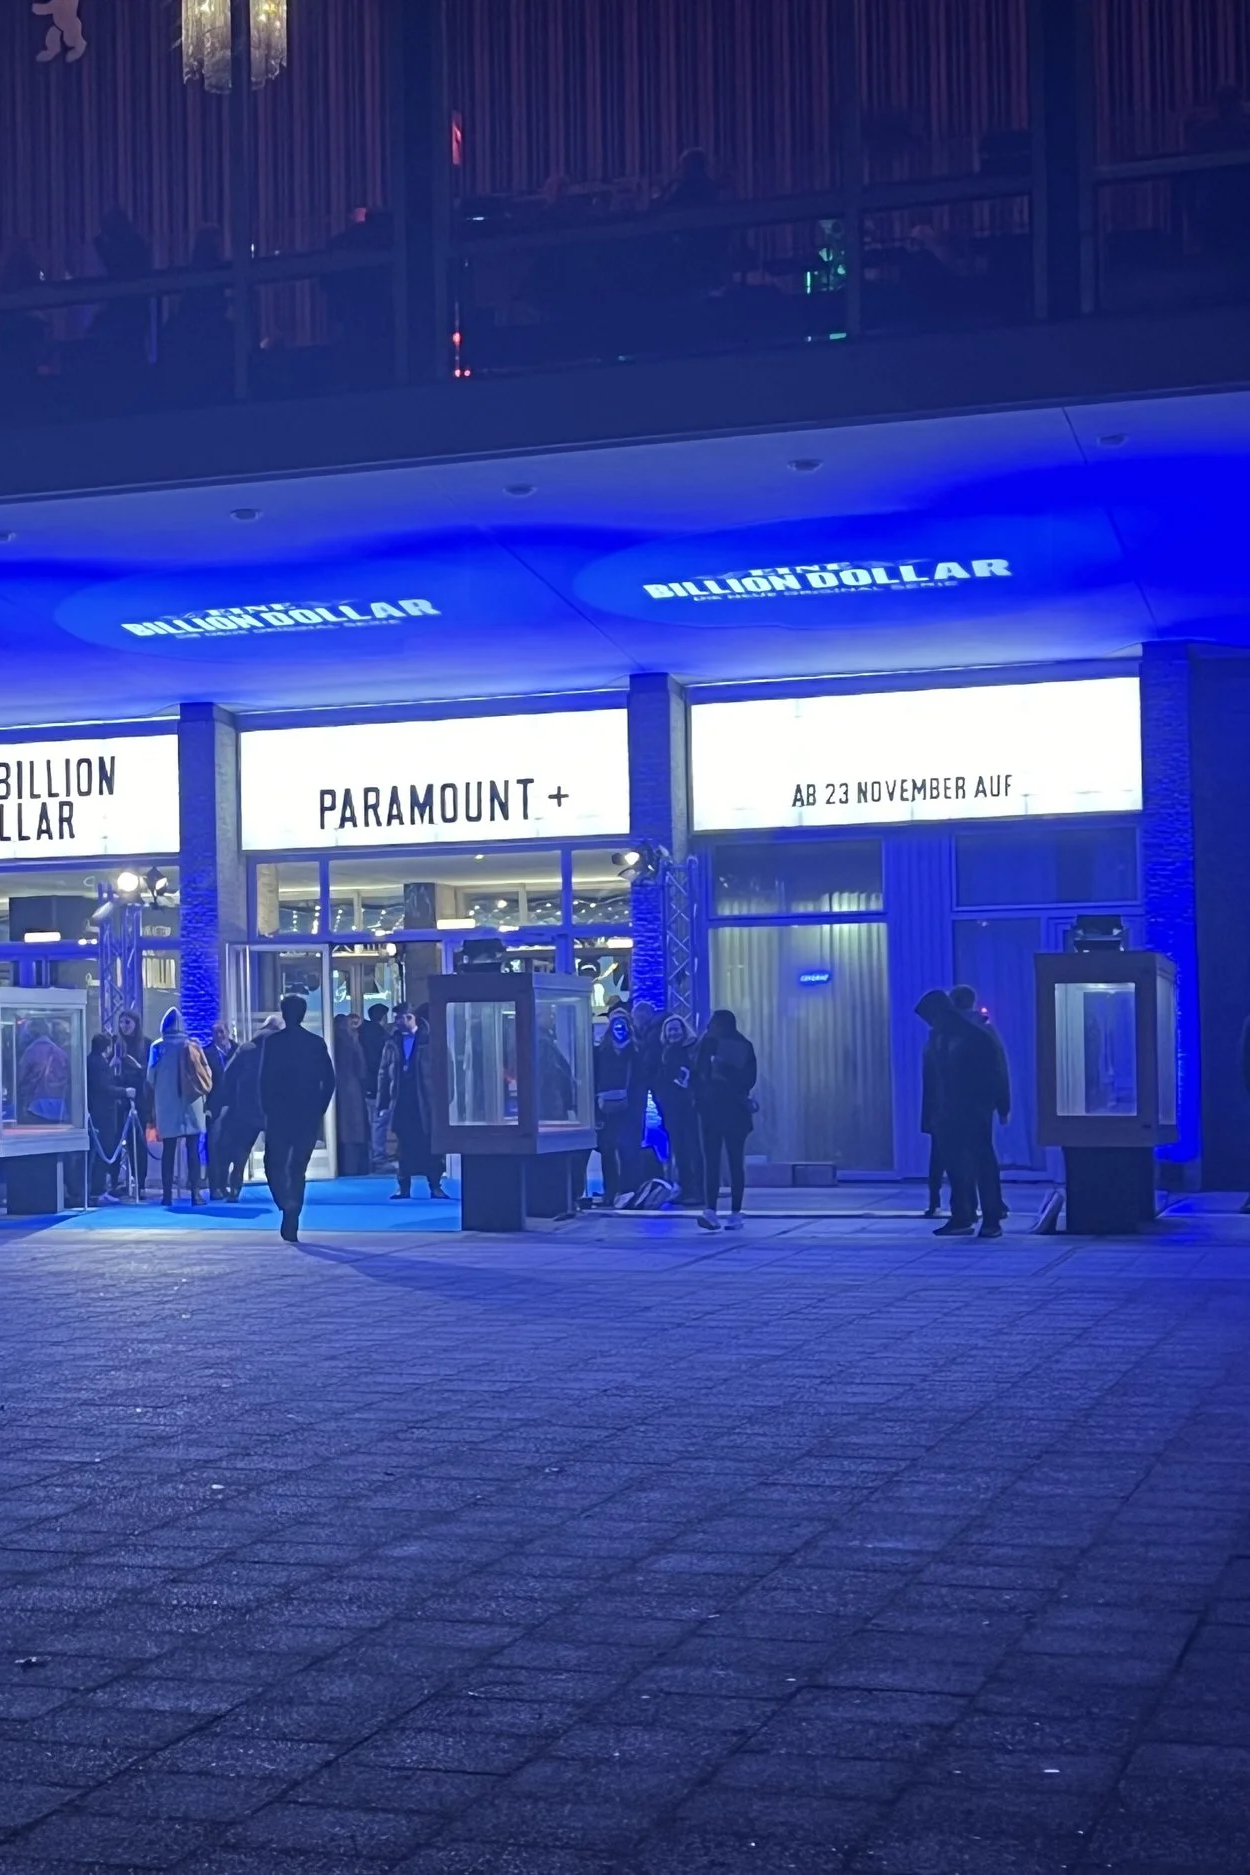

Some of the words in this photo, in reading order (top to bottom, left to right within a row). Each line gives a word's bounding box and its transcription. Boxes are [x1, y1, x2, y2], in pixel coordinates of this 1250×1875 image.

[643, 573, 802, 600] BILLION
[805, 558, 1013, 589] DOLLAR
[121, 612, 263, 637] BILLION
[260, 598, 442, 627] DOLLAR
[320, 778, 535, 830] PARAMOUNT
[792, 783, 817, 808] AB
[825, 782, 850, 805] 23
[857, 775, 966, 804] NOVEMBER
[975, 774, 1013, 799] AUF
